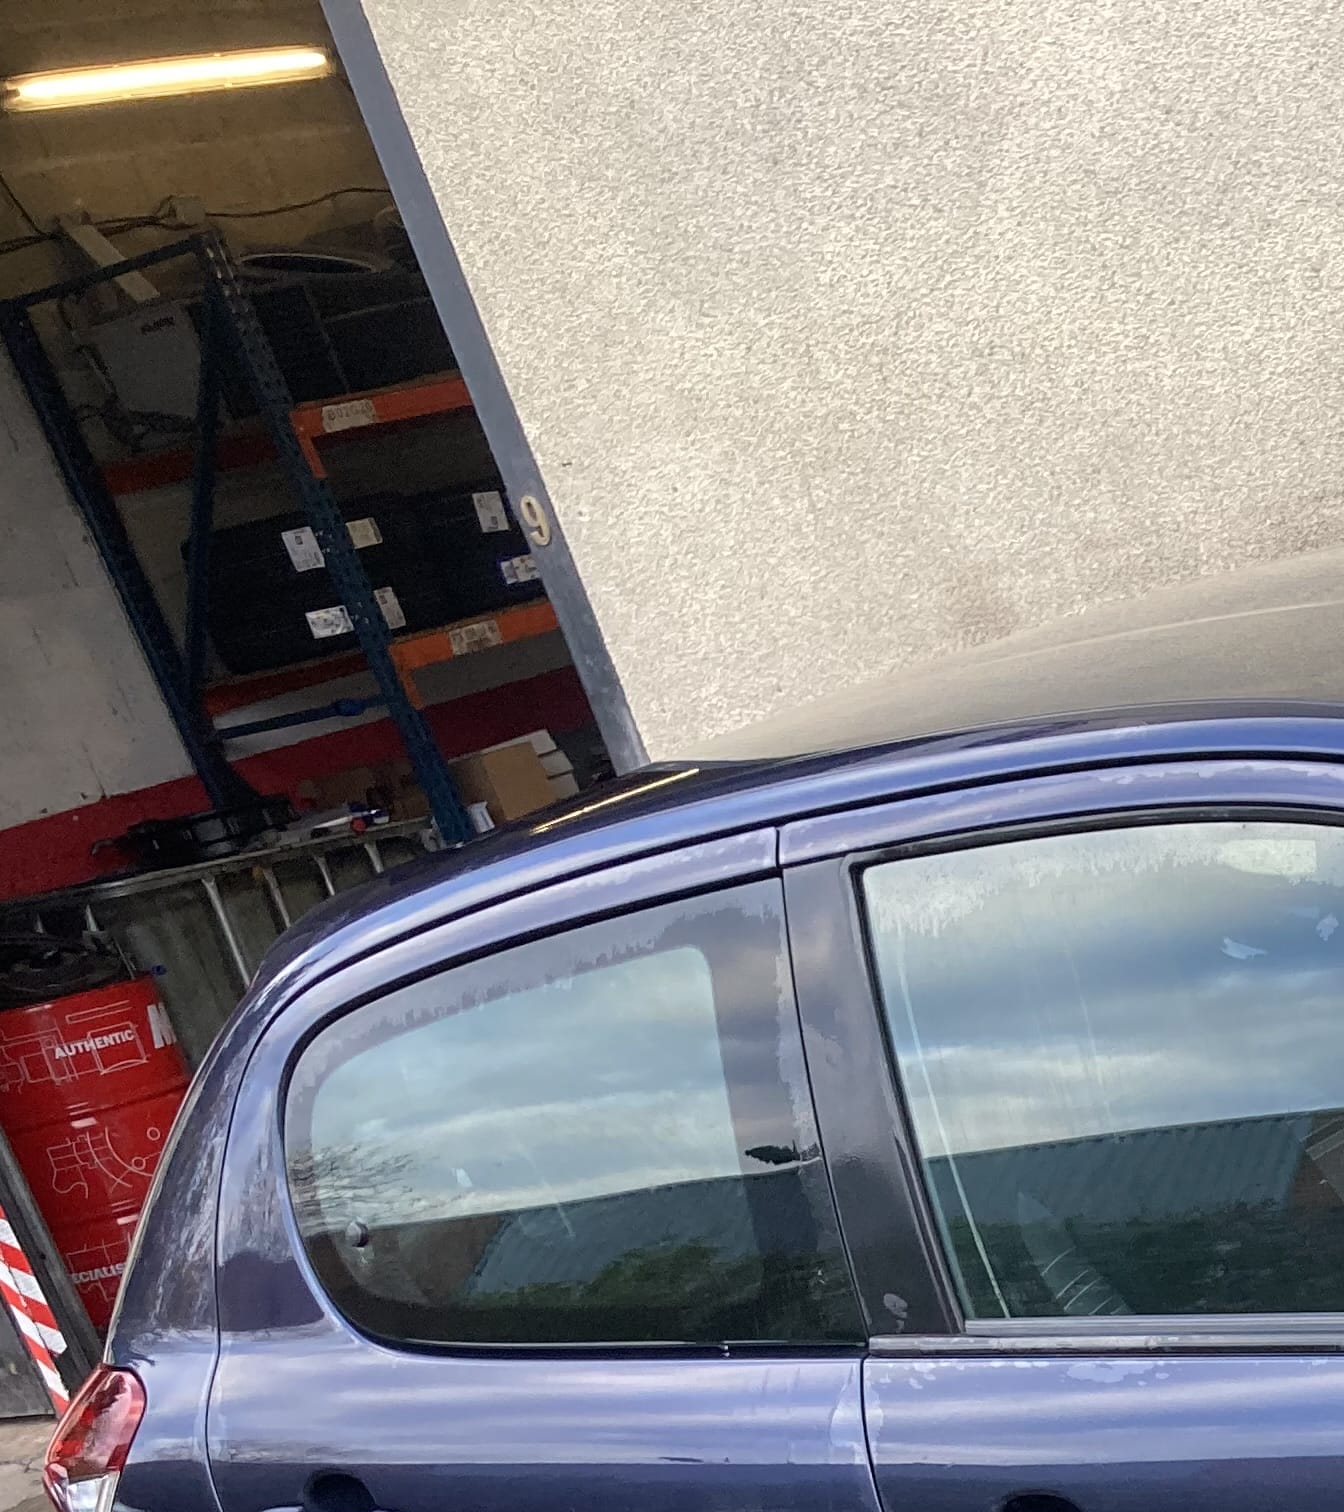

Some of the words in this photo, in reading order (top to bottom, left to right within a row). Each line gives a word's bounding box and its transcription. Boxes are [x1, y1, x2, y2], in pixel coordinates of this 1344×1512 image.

[521, 495, 552, 546] 9
[55, 1029, 135, 1059] AUTHENTIC
[71, 1262, 128, 1284] ECIALIS
